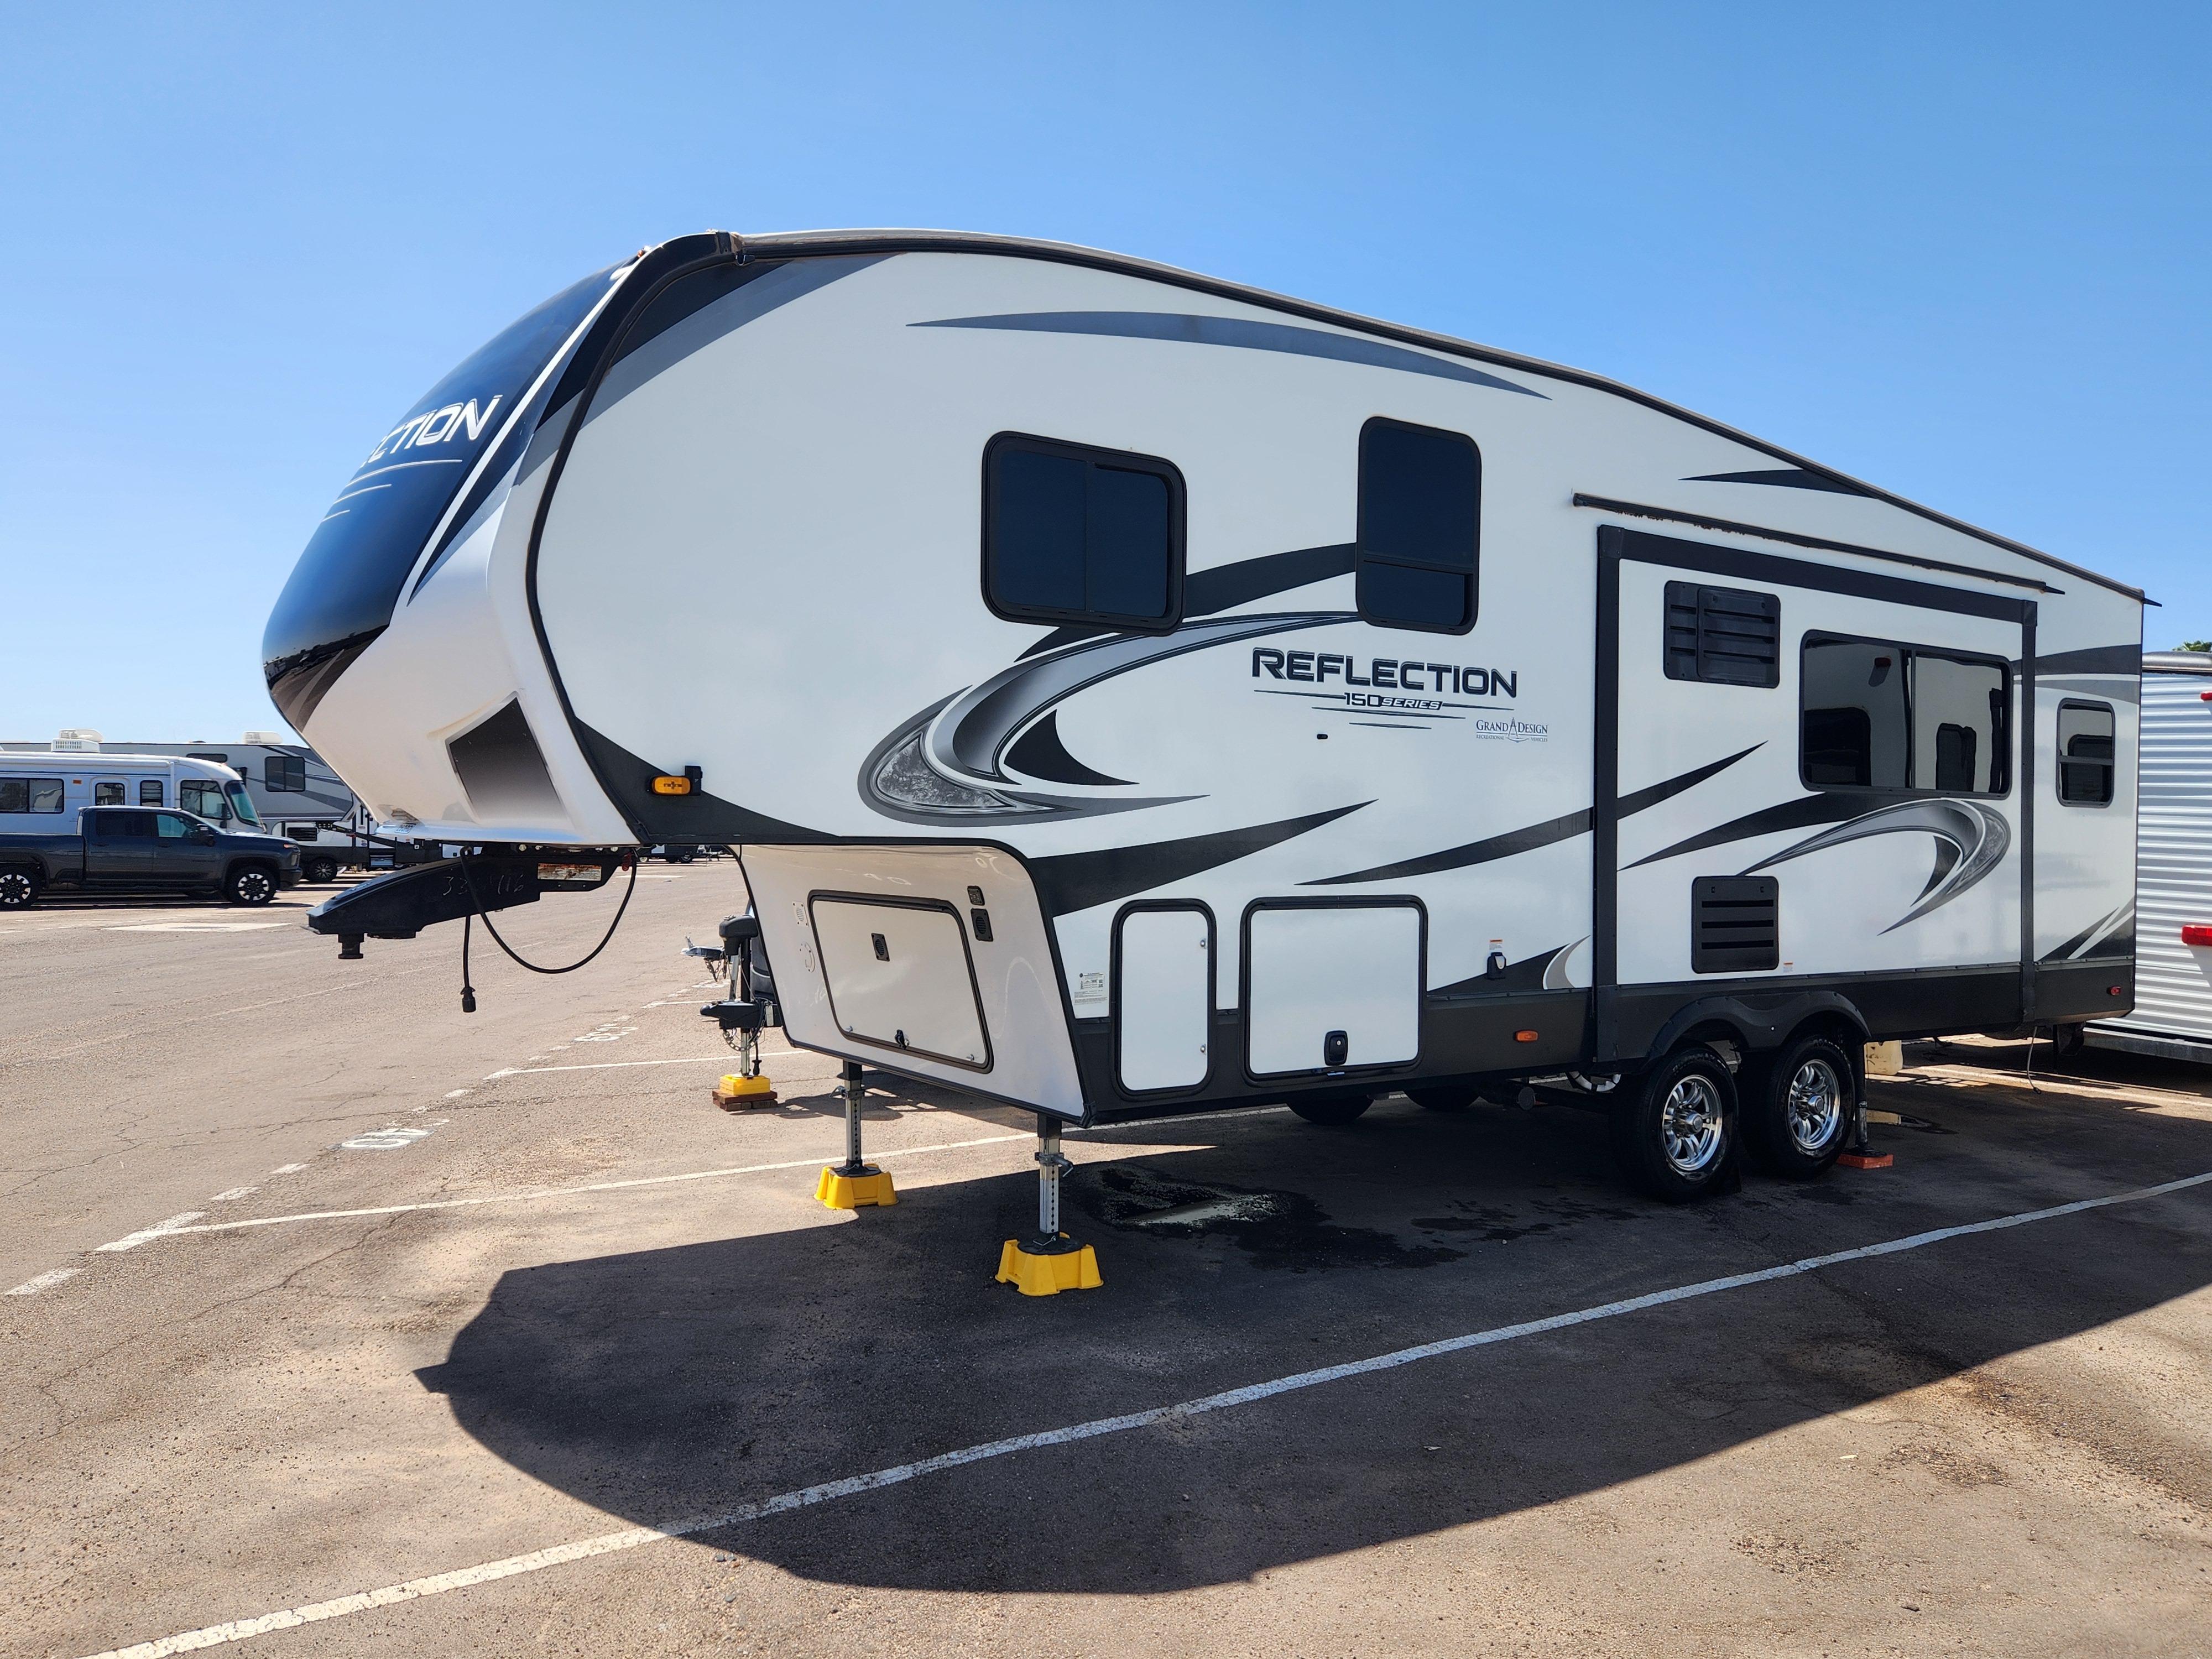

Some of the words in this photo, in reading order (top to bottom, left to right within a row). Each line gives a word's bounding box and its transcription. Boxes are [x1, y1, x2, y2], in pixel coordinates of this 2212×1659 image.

[360, 394, 503, 468] CTION
[1252, 647, 1517, 698] REFLECTION
[1344, 692, 1382, 706] 150
[1381, 698, 1441, 710] SERIES
